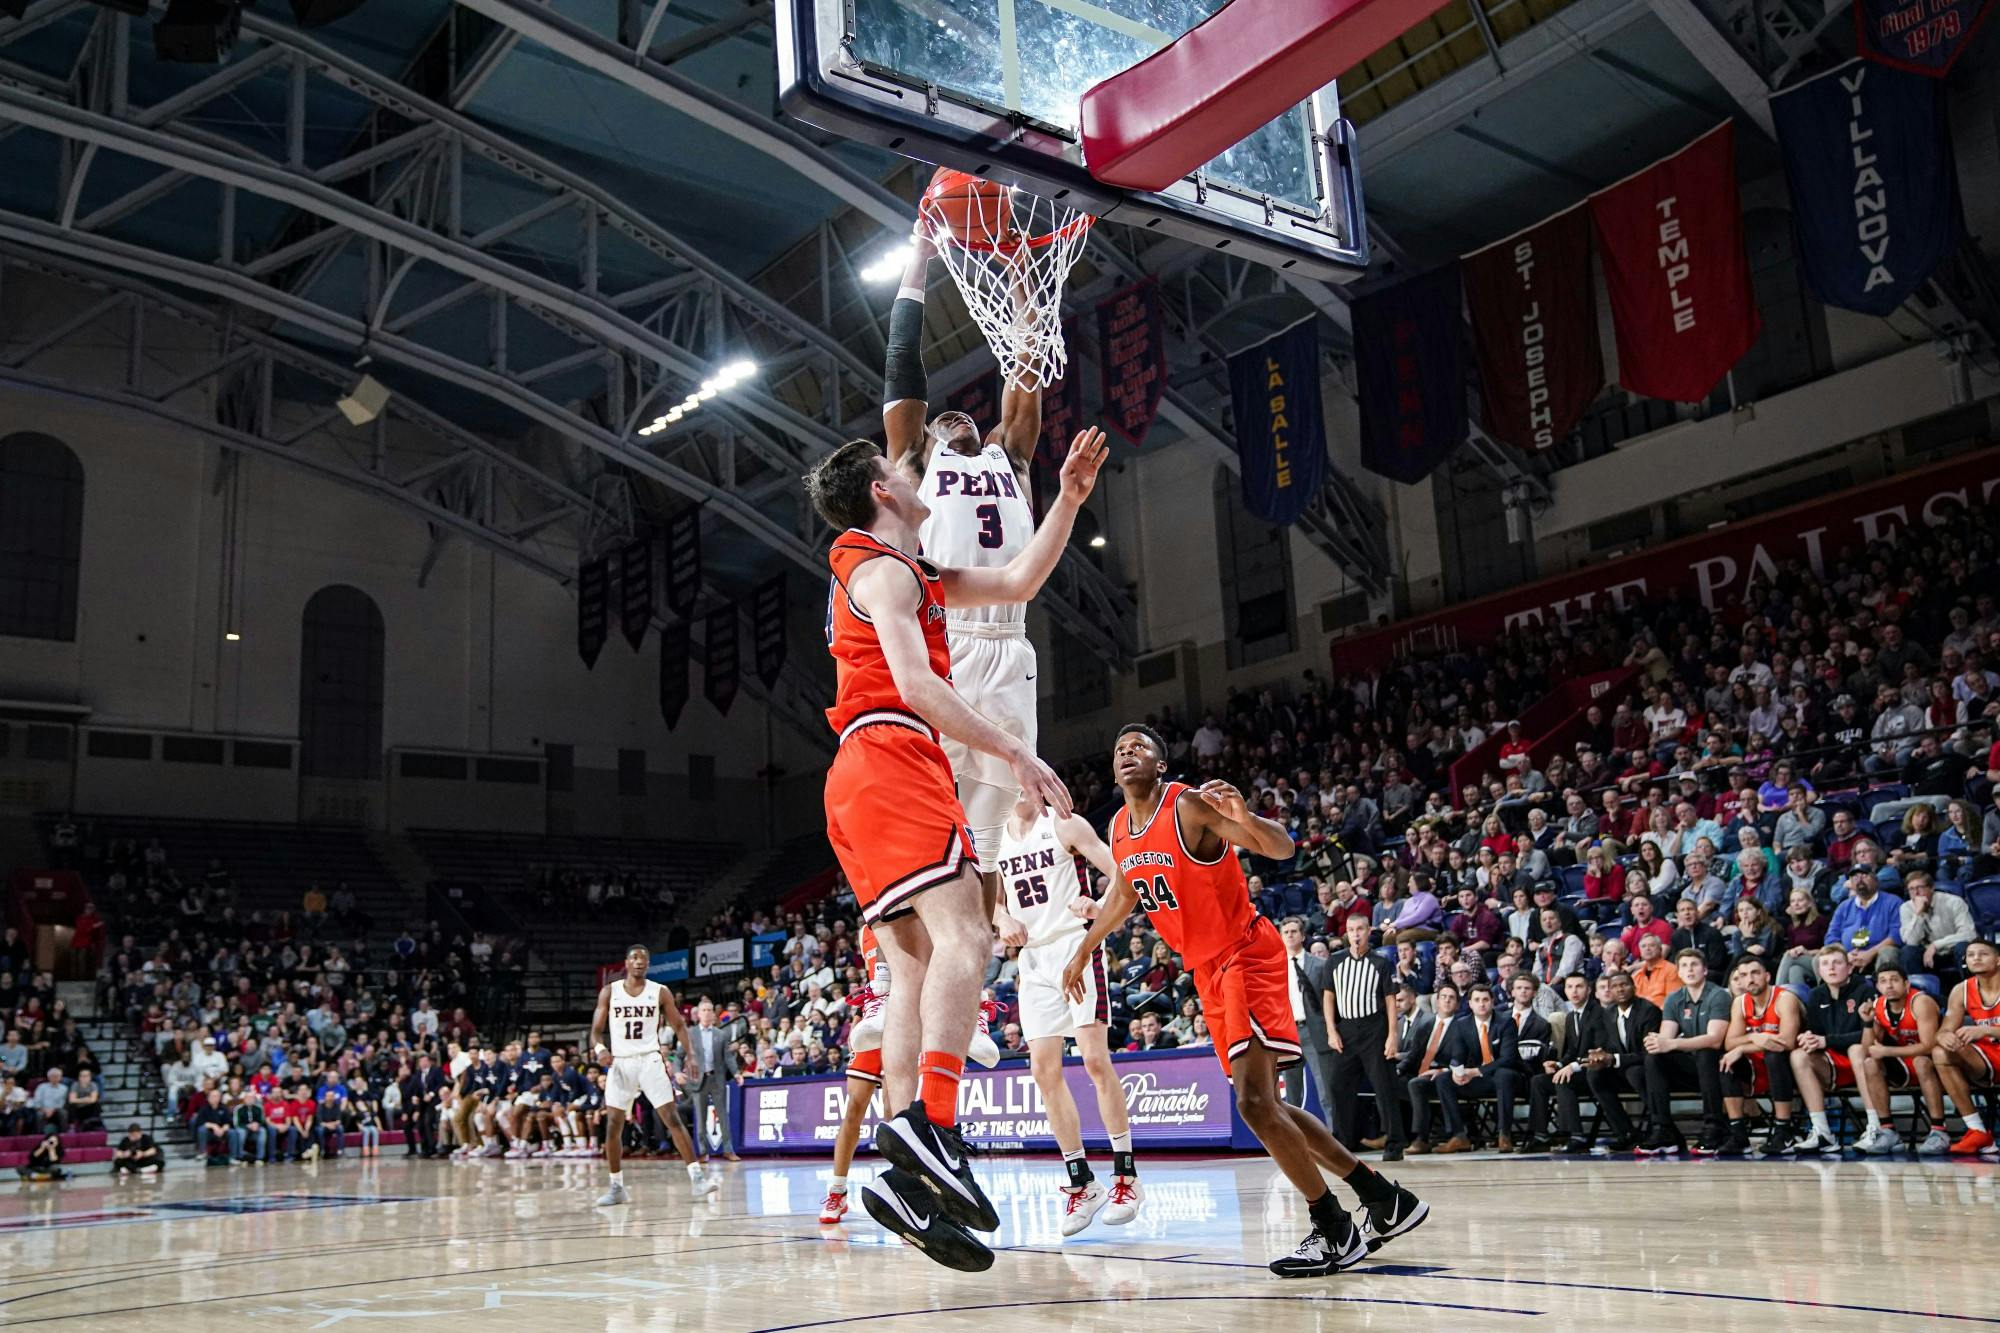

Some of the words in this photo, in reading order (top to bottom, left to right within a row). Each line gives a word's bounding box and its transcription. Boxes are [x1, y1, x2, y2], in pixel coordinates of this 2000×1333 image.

[1904, 9, 1961, 57] 1979
[1839, 67, 1894, 293] VILLANOVA
[1655, 196, 1696, 333] TEMPLE
[1513, 242, 1533, 290] ST.
[1523, 302, 1554, 450] JOSEPHS
[1266, 358, 1284, 389] LA
[1269, 397, 1293, 489] SALLE
[936, 470, 1018, 500] PENN
[975, 504, 1003, 549] 3
[998, 848, 1056, 878] PENN
[1014, 874, 1050, 909] 25
[1132, 873, 1179, 912] 34
[613, 1005, 657, 1018] PENN
[624, 1020, 644, 1040] 12
[823, 1086, 884, 1121] EVN
[958, 1077, 1003, 1116] TAL
[1120, 1072, 1209, 1113] Panache
[814, 1125, 871, 1140] PREFED
[989, 1121, 1015, 1136] THE
[991, 1141, 1024, 1149] PALESTRA
